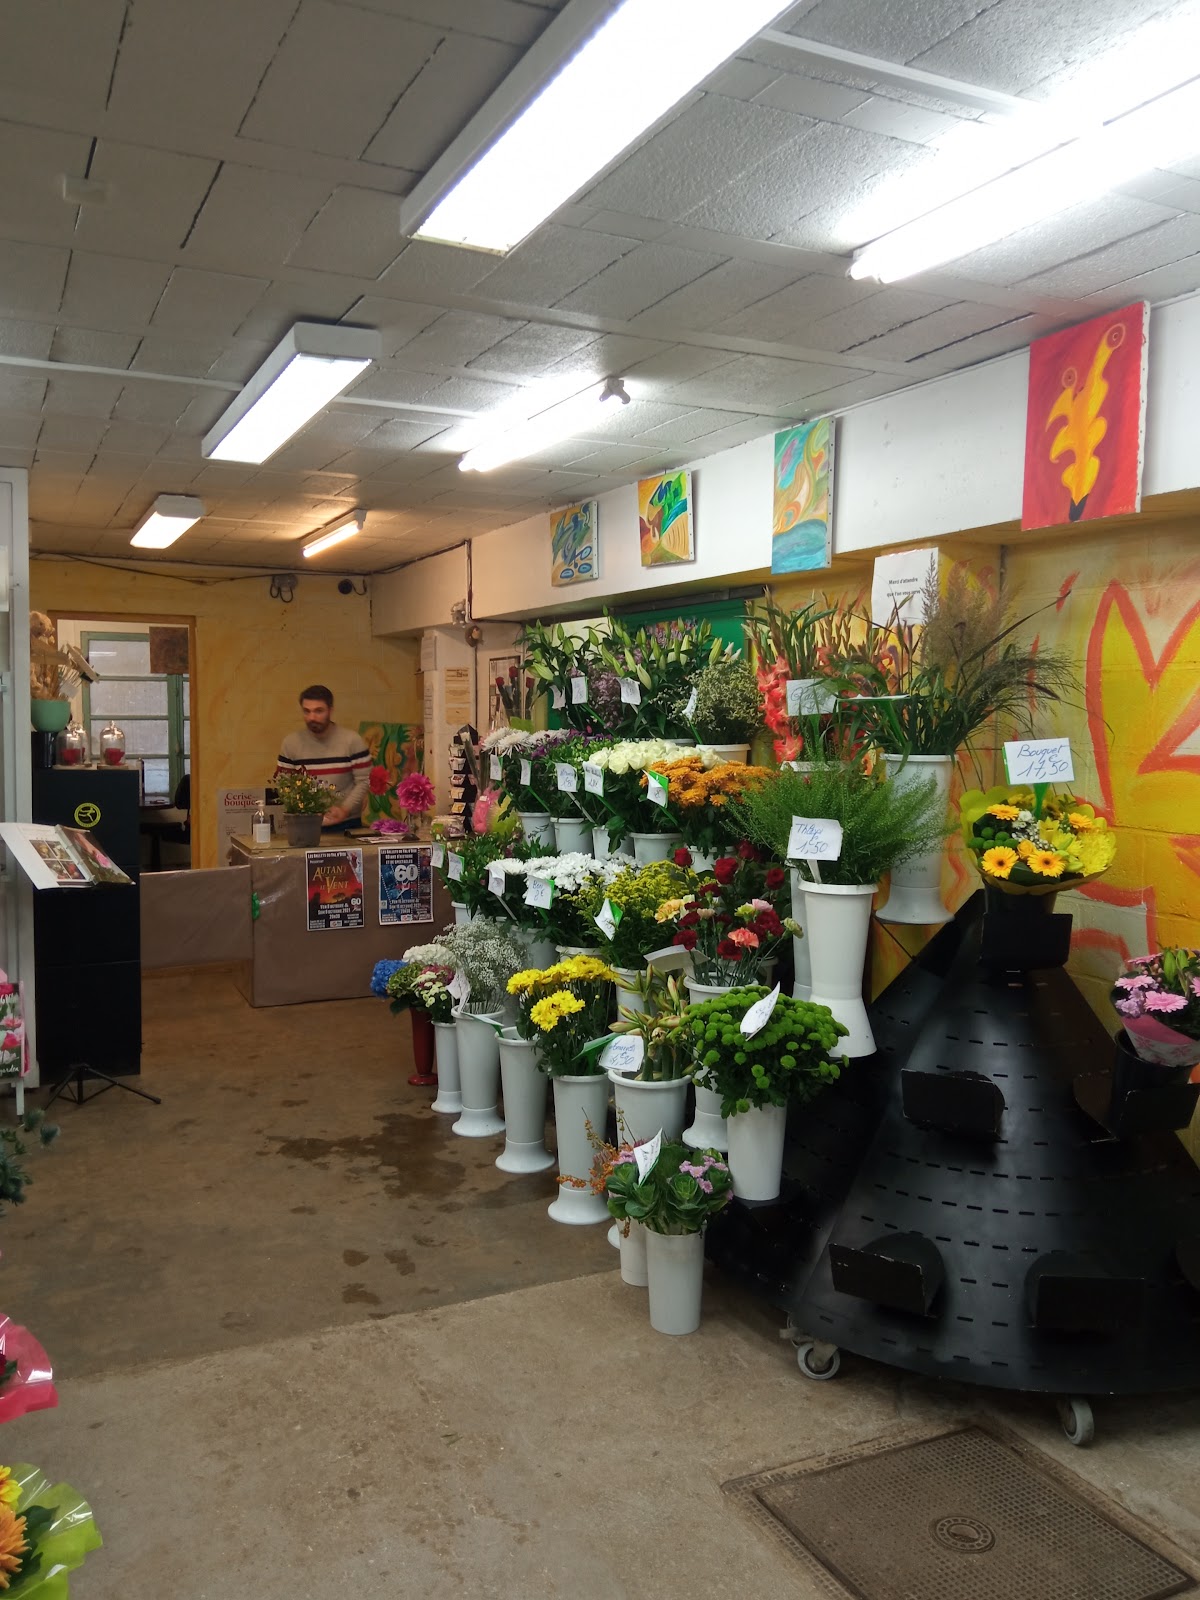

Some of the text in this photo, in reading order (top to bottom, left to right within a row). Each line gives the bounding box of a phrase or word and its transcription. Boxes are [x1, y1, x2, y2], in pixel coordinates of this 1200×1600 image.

[1017, 744, 1069, 763] Bouquet
[225, 792, 252, 801] Cerise
[312, 866, 346, 880] AUTANT
[394, 864, 418, 882] 60
[325, 876, 348, 894] VENT
[351, 898, 361, 906] 60
